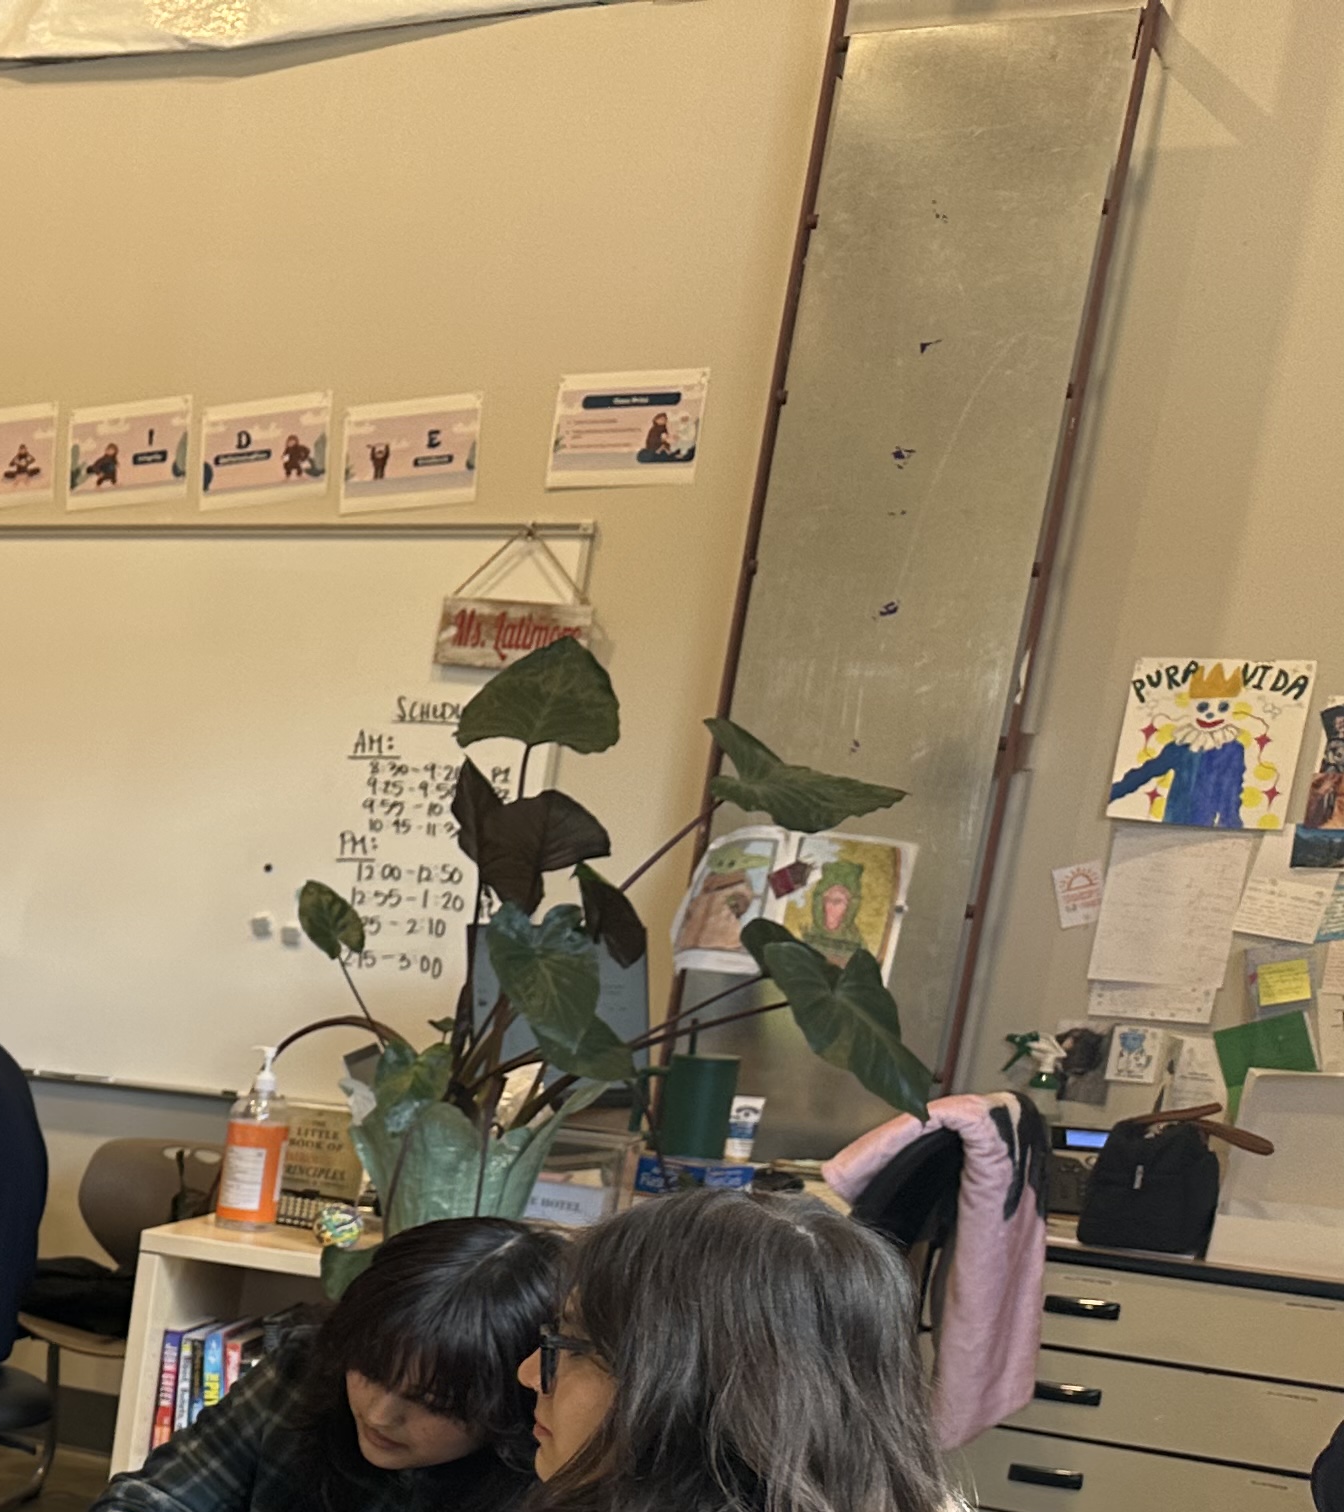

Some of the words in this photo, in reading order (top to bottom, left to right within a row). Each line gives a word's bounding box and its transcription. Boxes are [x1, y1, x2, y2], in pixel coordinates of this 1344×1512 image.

[234, 430, 252, 449] D
[427, 429, 442, 448] E
[1131, 660, 1199, 703] PURA
[1242, 662, 1309, 700] VIDA
[296, 1126, 340, 1140] LITTLE
[285, 1163, 347, 1181] RINCIPLES
